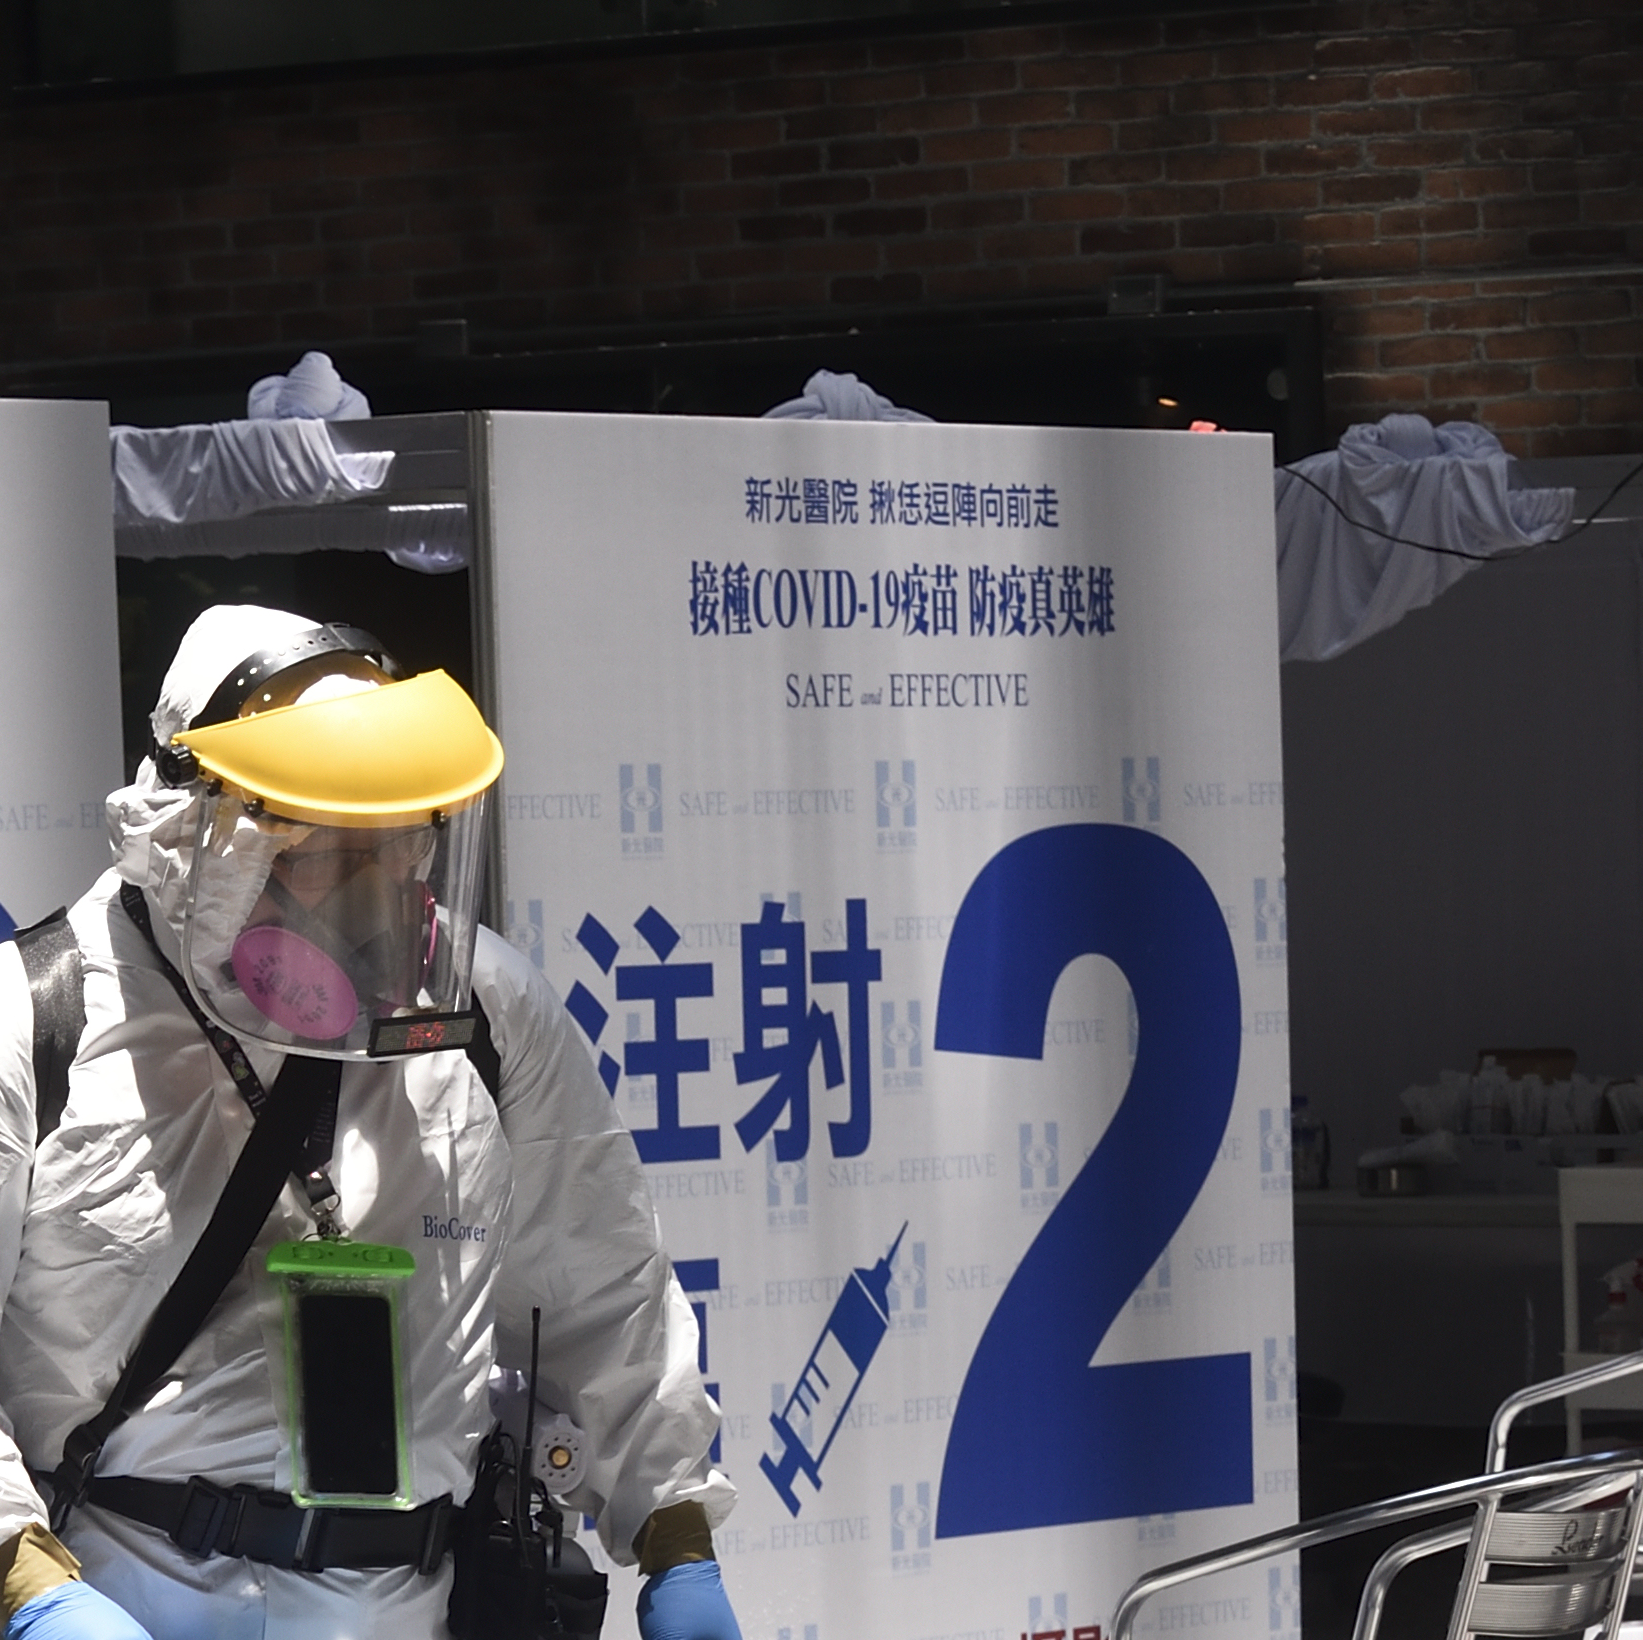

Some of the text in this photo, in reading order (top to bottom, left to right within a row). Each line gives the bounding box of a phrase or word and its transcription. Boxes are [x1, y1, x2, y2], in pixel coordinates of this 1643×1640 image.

[745, 477, 1059, 528] 新光醫院 揪恁逗陣向前走
[689, 561, 1115, 637] 接種COVID-19疫苗 防疫真英雄
[786, 673, 1029, 709] SAFE and EFFECTIVE
[508, 794, 601, 820] FFECTIVE
[680, 792, 728, 817] SAFE
[754, 790, 855, 815] EFFECTIVE
[935, 785, 1100, 812] SAFE EFFECTIVE
[1184, 783, 1227, 807] SAFE
[565, 898, 883, 1165] 注射
[828, 1162, 874, 1188] SAFE
[900, 1154, 996, 1183] EFFECTIVE
[934, 822, 1254, 1539] 2
[422, 1215, 486, 1242] BioCover
[1194, 1246, 1236, 1270] SAFE
[946, 1265, 991, 1291] SAFE
[771, 1517, 870, 1550] EFFECTIVE
[1159, 1598, 1252, 1631] EFFECTIVE
